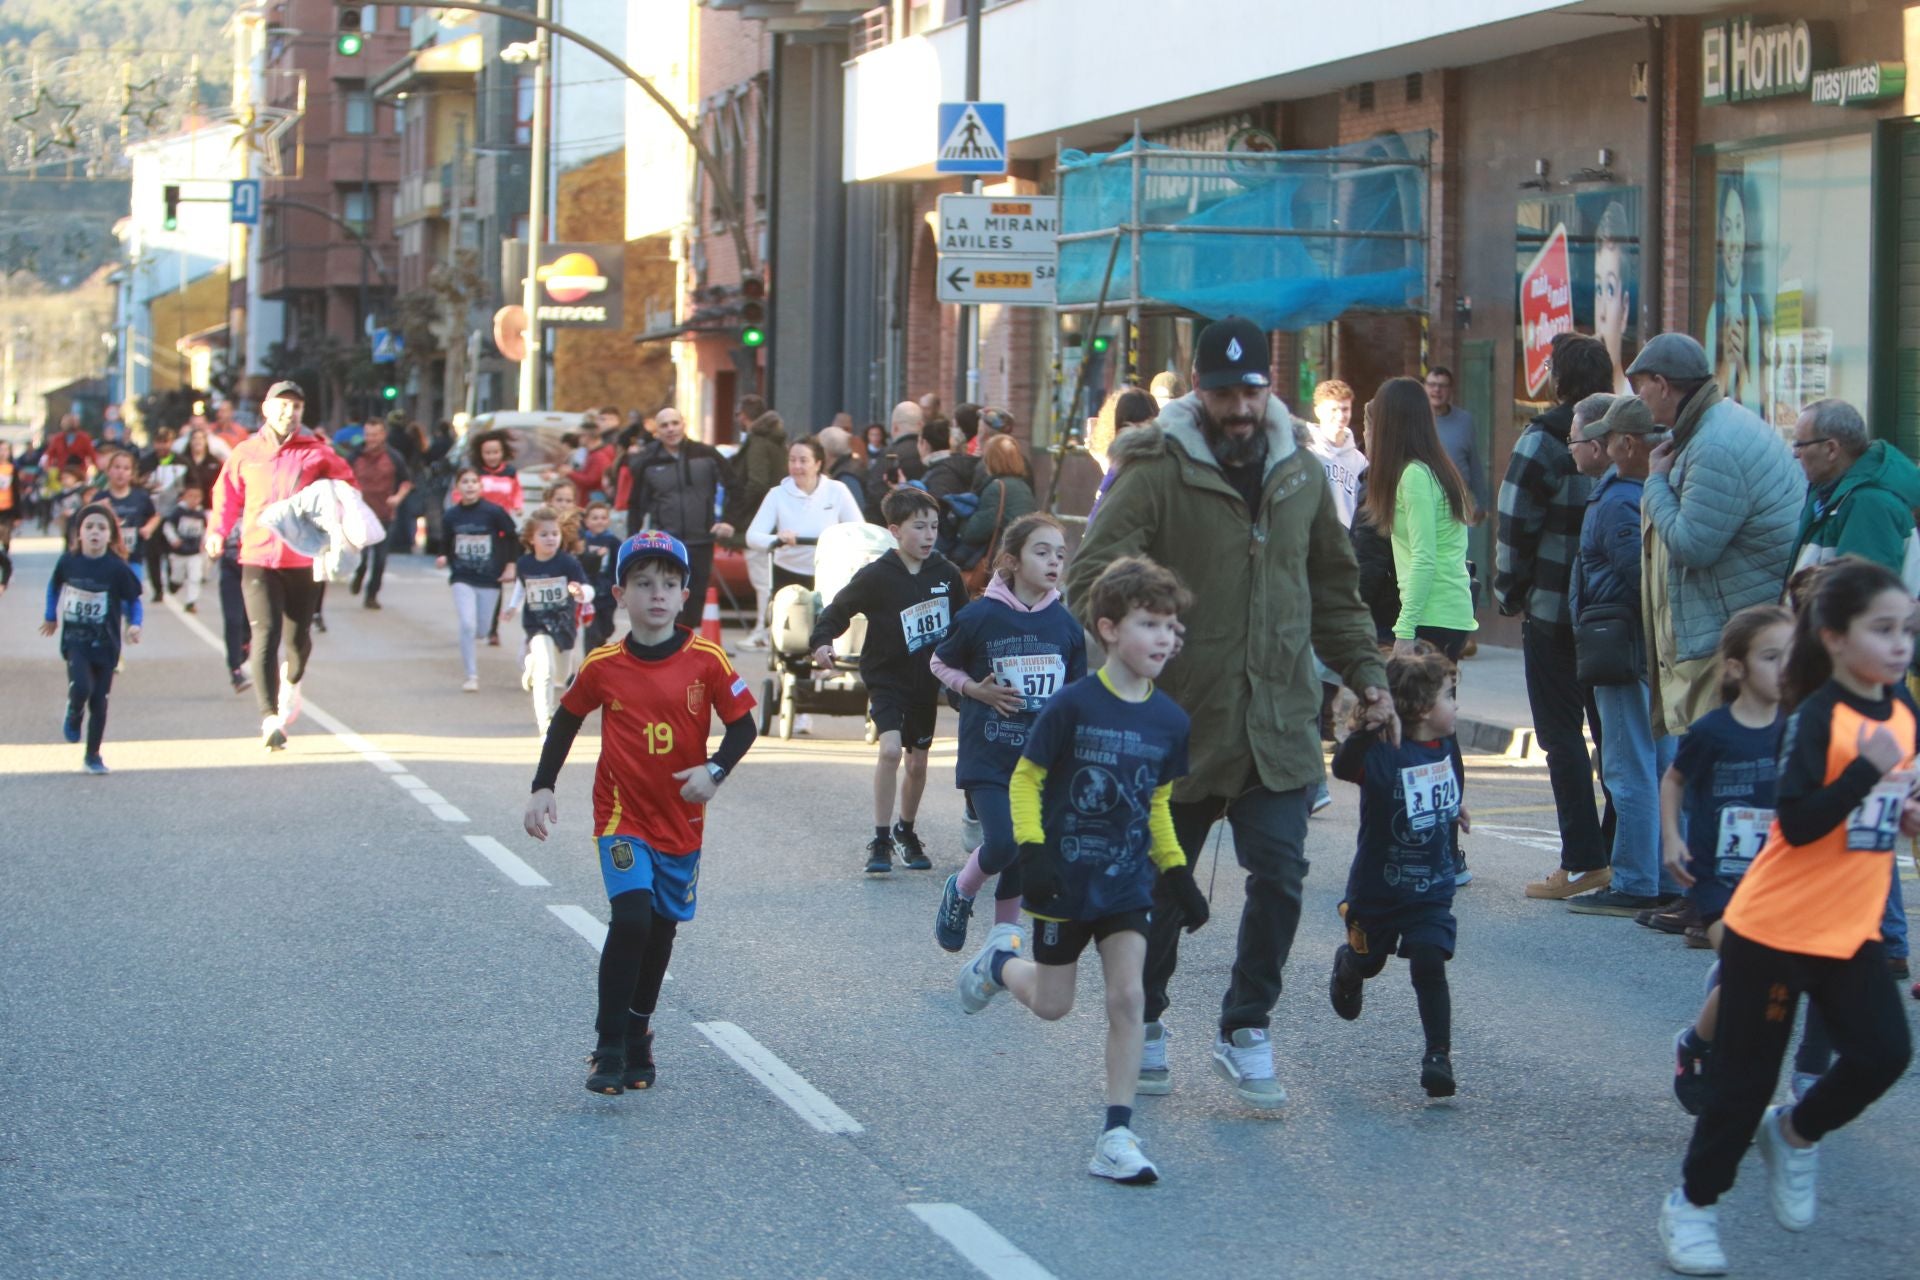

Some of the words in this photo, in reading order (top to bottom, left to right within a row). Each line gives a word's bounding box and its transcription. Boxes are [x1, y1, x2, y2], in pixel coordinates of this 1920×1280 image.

[1703, 26, 1725, 97] El
[1731, 20, 1810, 92] Horno
[1812, 62, 1878, 106] masymas
[945, 218, 968, 230] LA
[946, 235, 1013, 249] AVILES
[537, 306, 608, 321] REPSOL
[539, 588, 563, 601] 709
[76, 601, 101, 616] 692
[917, 612, 942, 634] 481
[1003, 659, 1019, 668] SAN
[1021, 656, 1056, 666] SILVESTRE
[1023, 673, 1056, 696] 577
[643, 722, 674, 755] 19
[1074, 747, 1118, 766] LLANERA
[1431, 778, 1456, 810] 624
